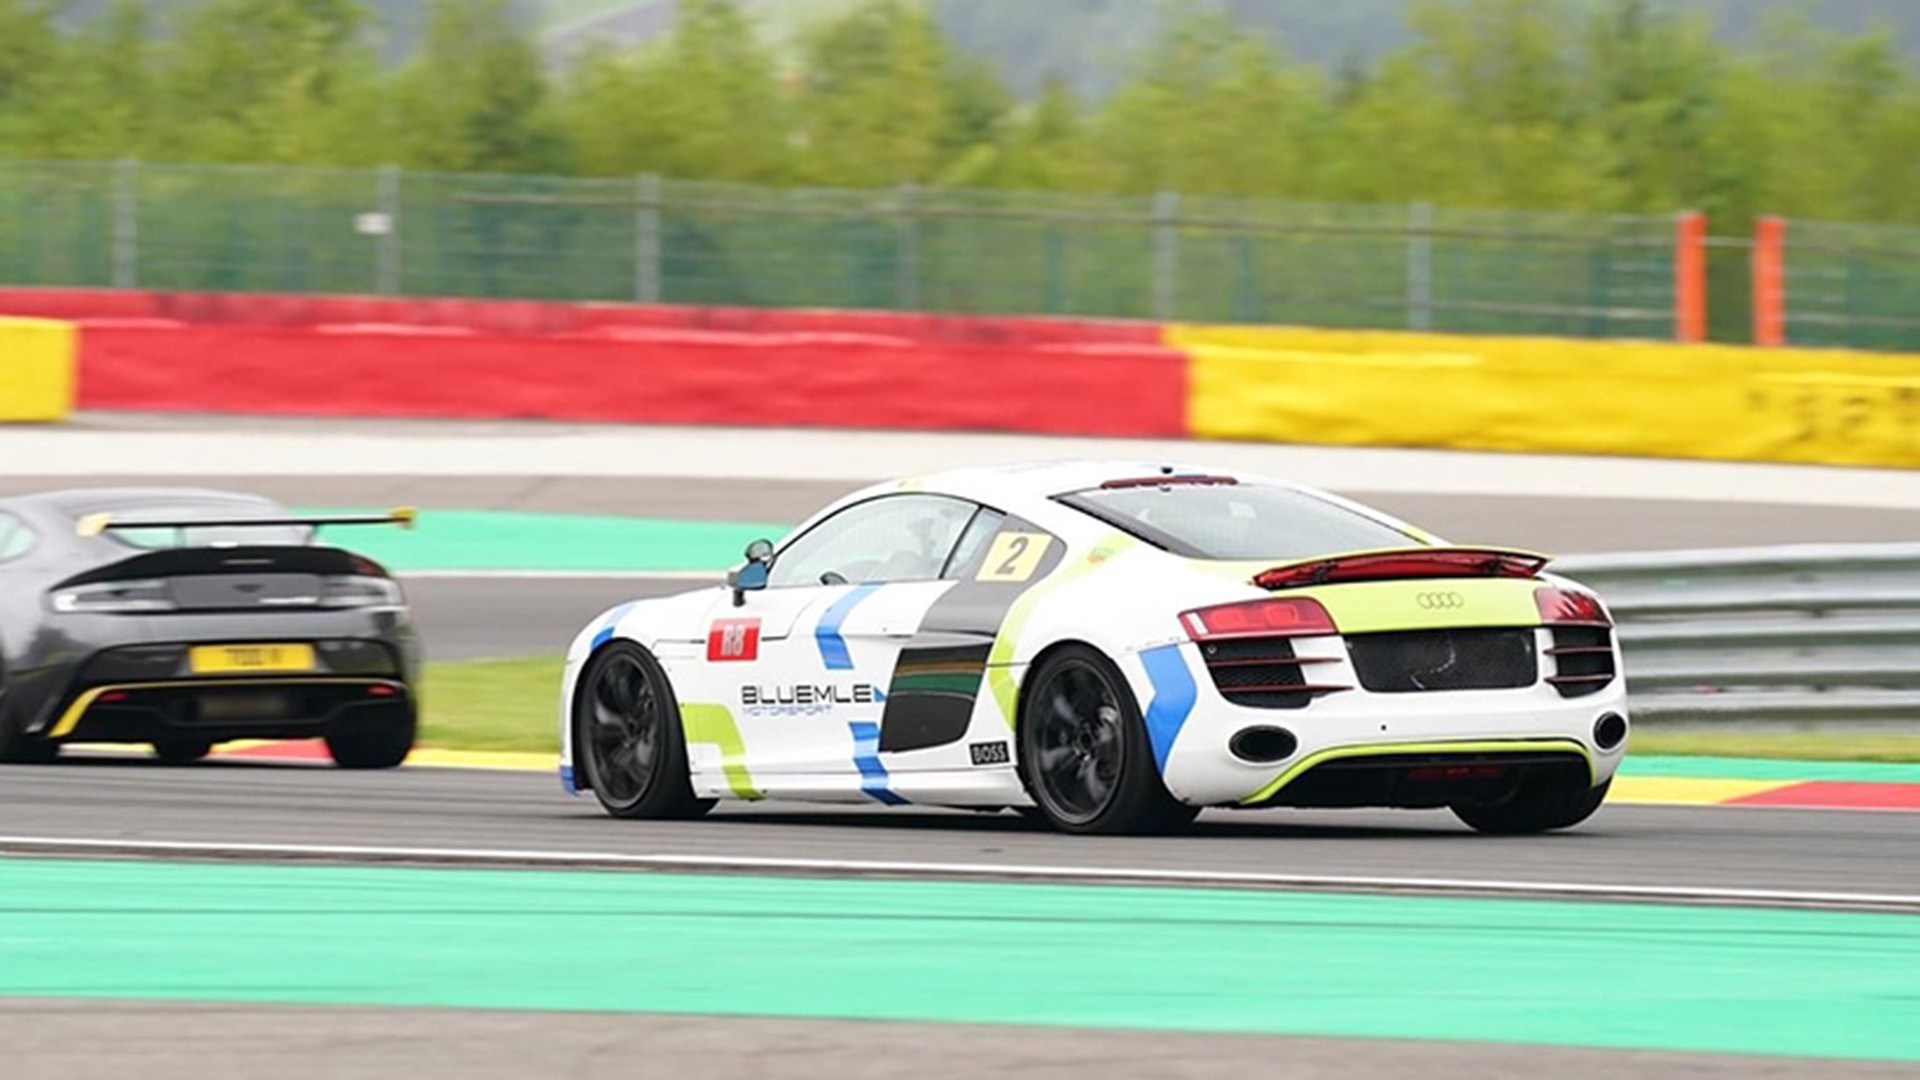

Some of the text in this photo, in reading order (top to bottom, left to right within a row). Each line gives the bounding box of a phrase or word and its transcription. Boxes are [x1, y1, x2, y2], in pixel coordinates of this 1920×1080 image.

[995, 536, 1029, 575] 2
[742, 684, 872, 704] BLUEMLE
[973, 743, 1006, 762] BOSS
